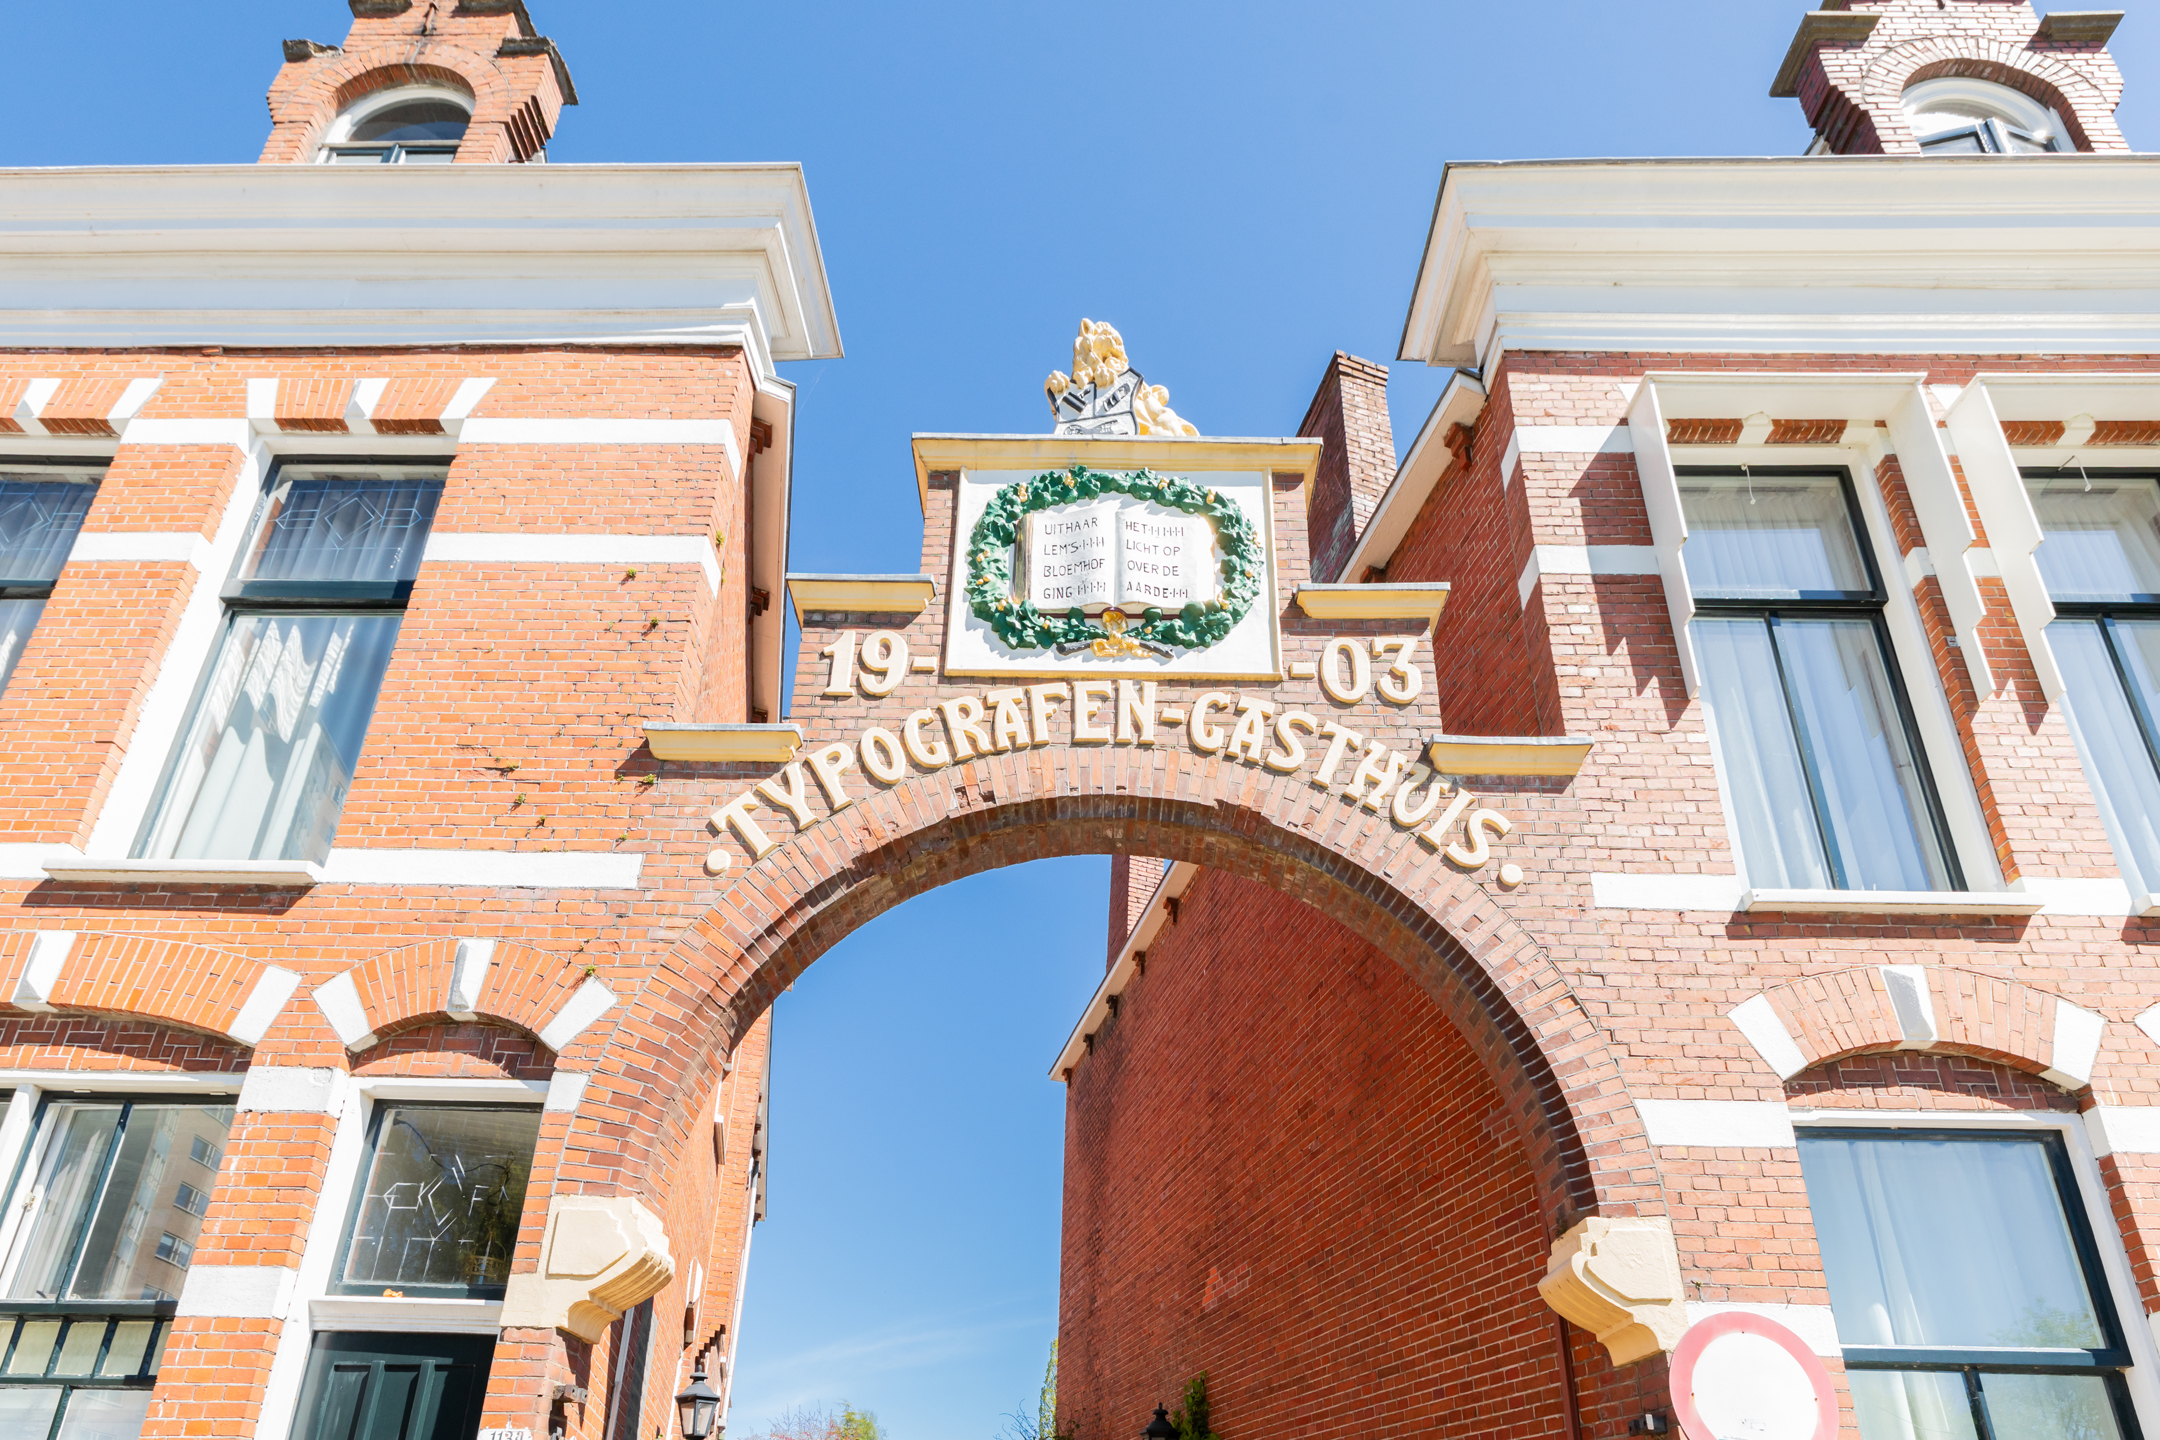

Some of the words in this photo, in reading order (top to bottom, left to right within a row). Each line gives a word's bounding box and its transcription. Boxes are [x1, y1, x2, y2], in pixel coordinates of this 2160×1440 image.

[1126, 539, 1159, 555] LICHT
[1163, 546, 1180, 556] OP
[1043, 558, 1105, 577] BLOEMHOF
[1127, 560, 1159, 574] OVER
[1163, 565, 1180, 576] DE
[1043, 586, 1072, 599] GING
